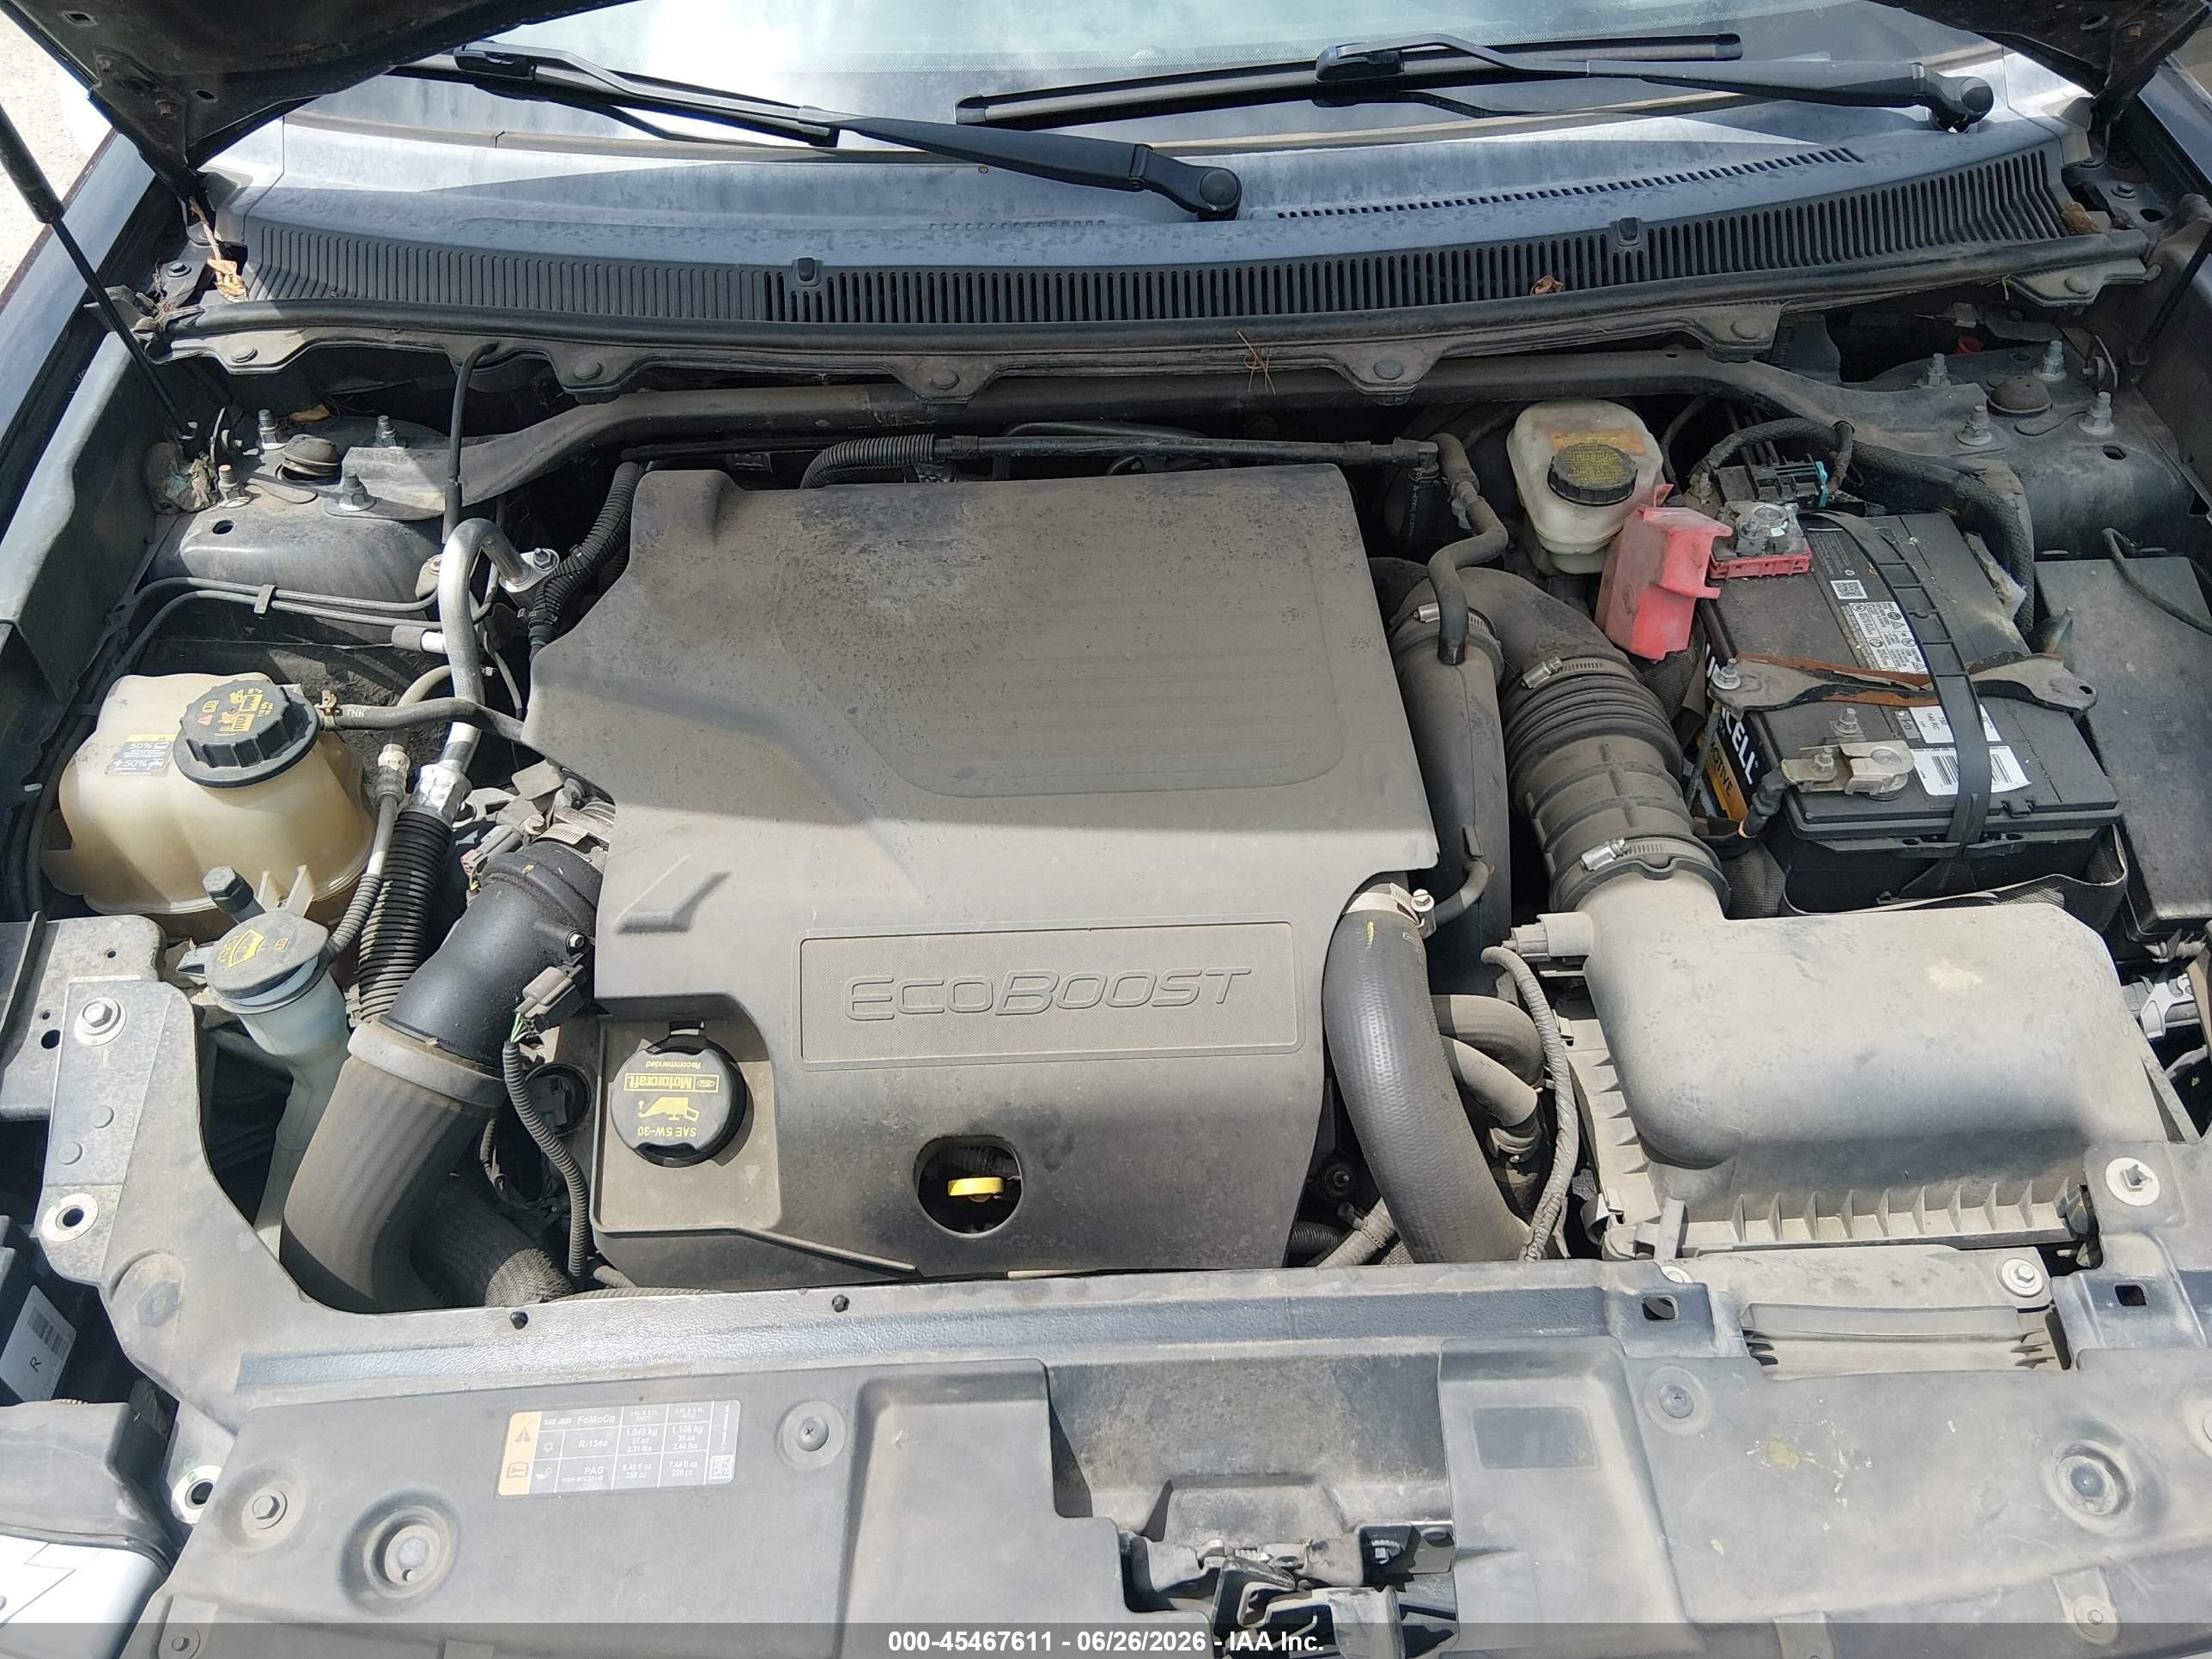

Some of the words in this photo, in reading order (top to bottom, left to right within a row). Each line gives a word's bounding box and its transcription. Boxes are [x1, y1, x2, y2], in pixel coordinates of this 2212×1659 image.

[646, 1060, 702, 1069] Recommended
[629, 1075, 693, 1089] Motorcraft
[638, 1127, 672, 1137] 5W-30
[675, 1127, 696, 1137] SAE
[29, 1356, 42, 1372] R
[577, 1414, 616, 1425] FoMoCo
[647, 1428, 659, 1437] kg
[693, 1425, 704, 1434] kg
[578, 1438, 608, 1449] R-134a
[584, 1465, 605, 1475] PAG
